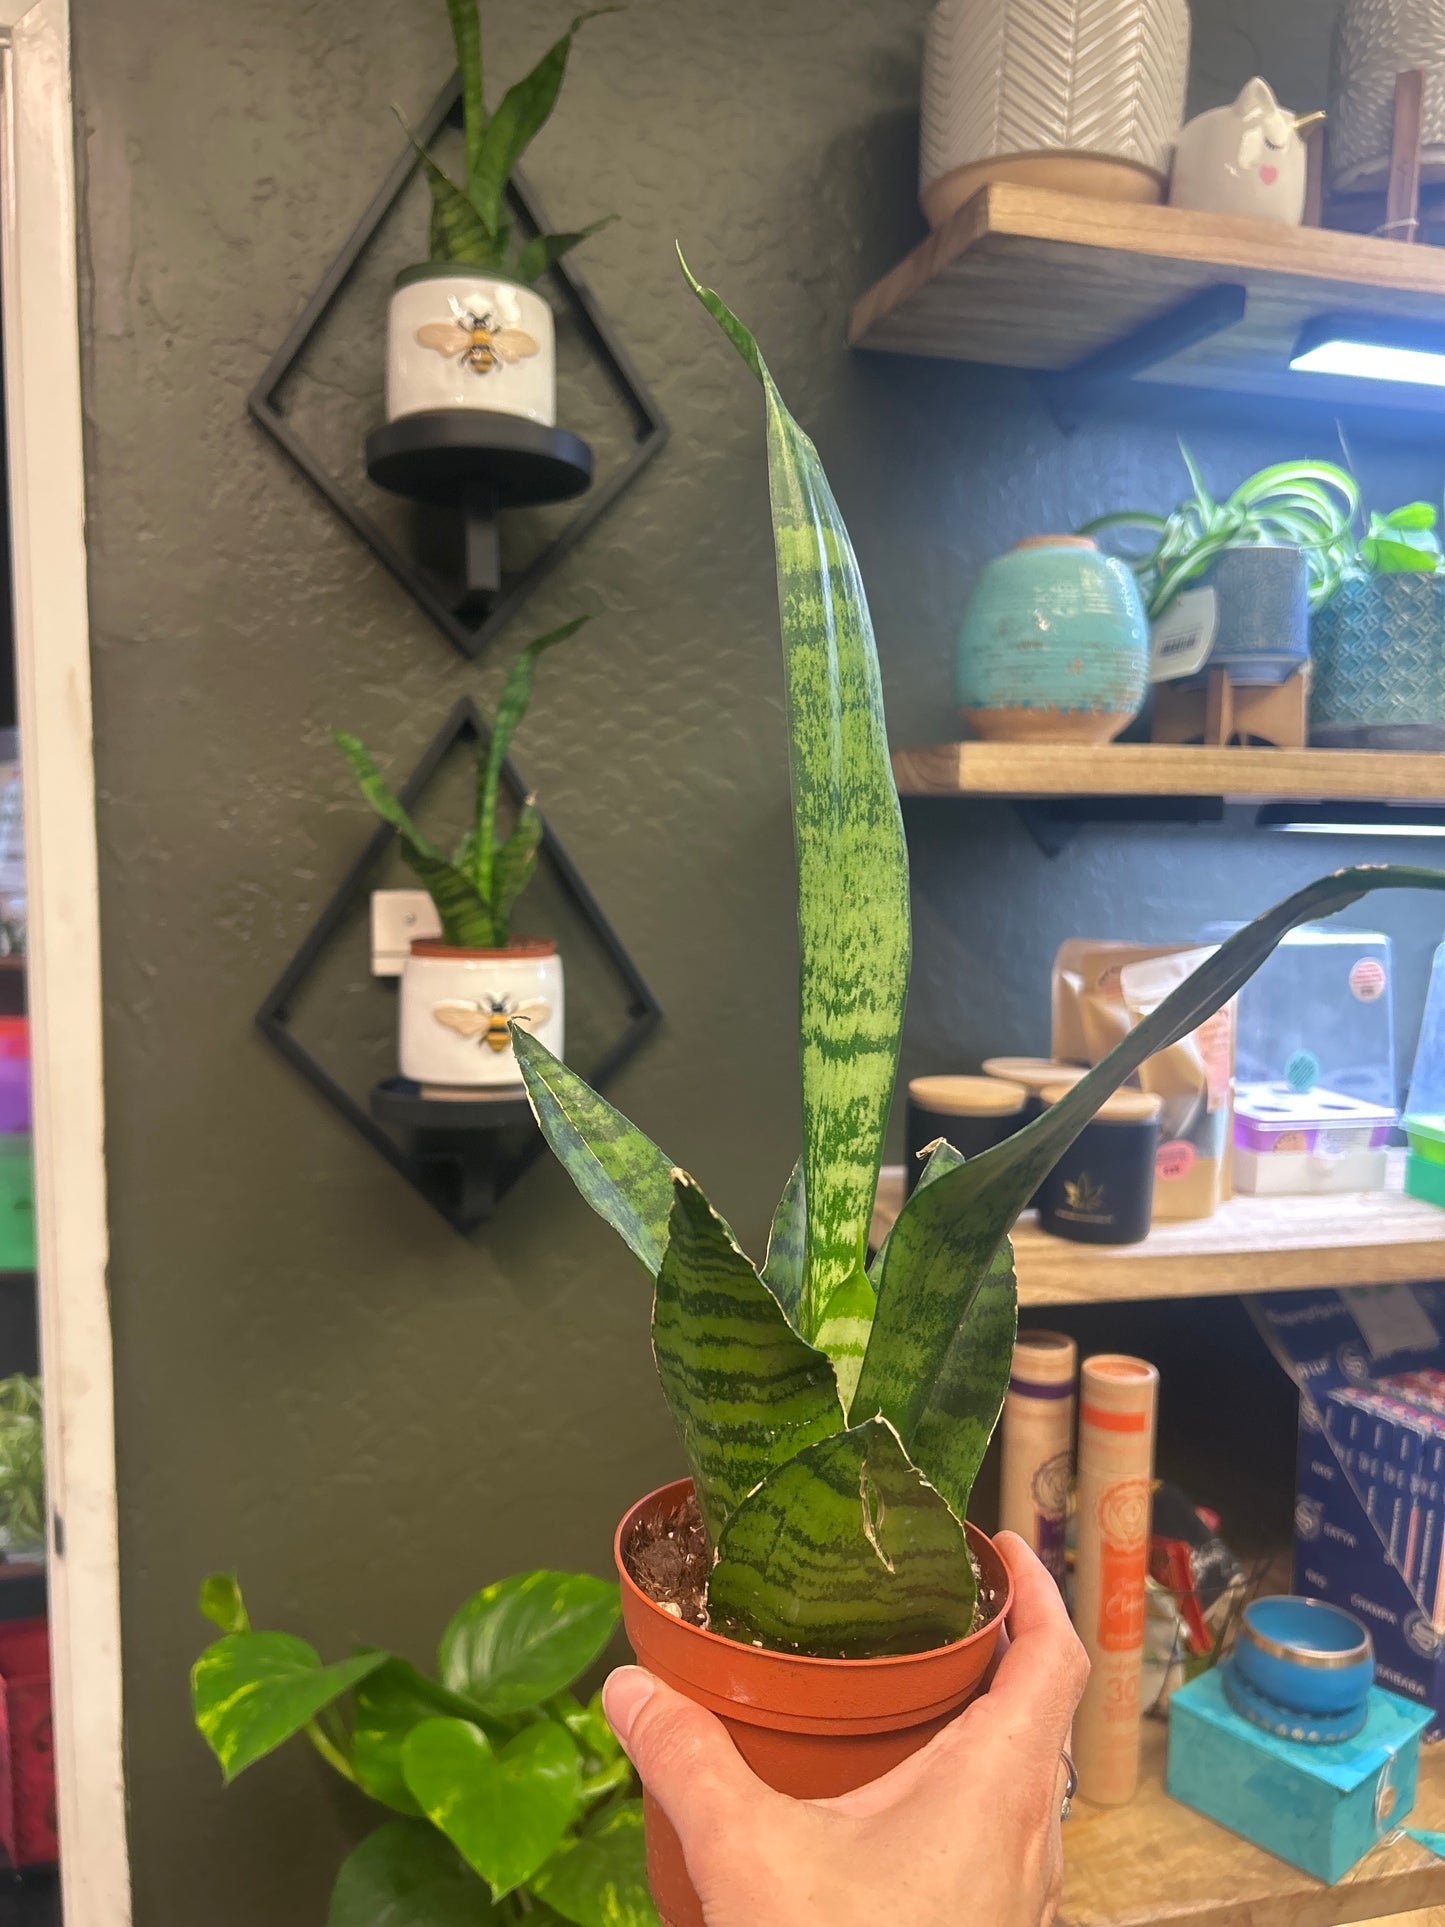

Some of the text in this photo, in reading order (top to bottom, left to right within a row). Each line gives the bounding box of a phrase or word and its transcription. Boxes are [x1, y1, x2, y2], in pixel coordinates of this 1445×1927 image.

[1323, 1522, 1357, 1549] SATYA
[1350, 1593, 1397, 1625] CHAMPA
[1375, 1664, 1427, 1697] SAIBABA
